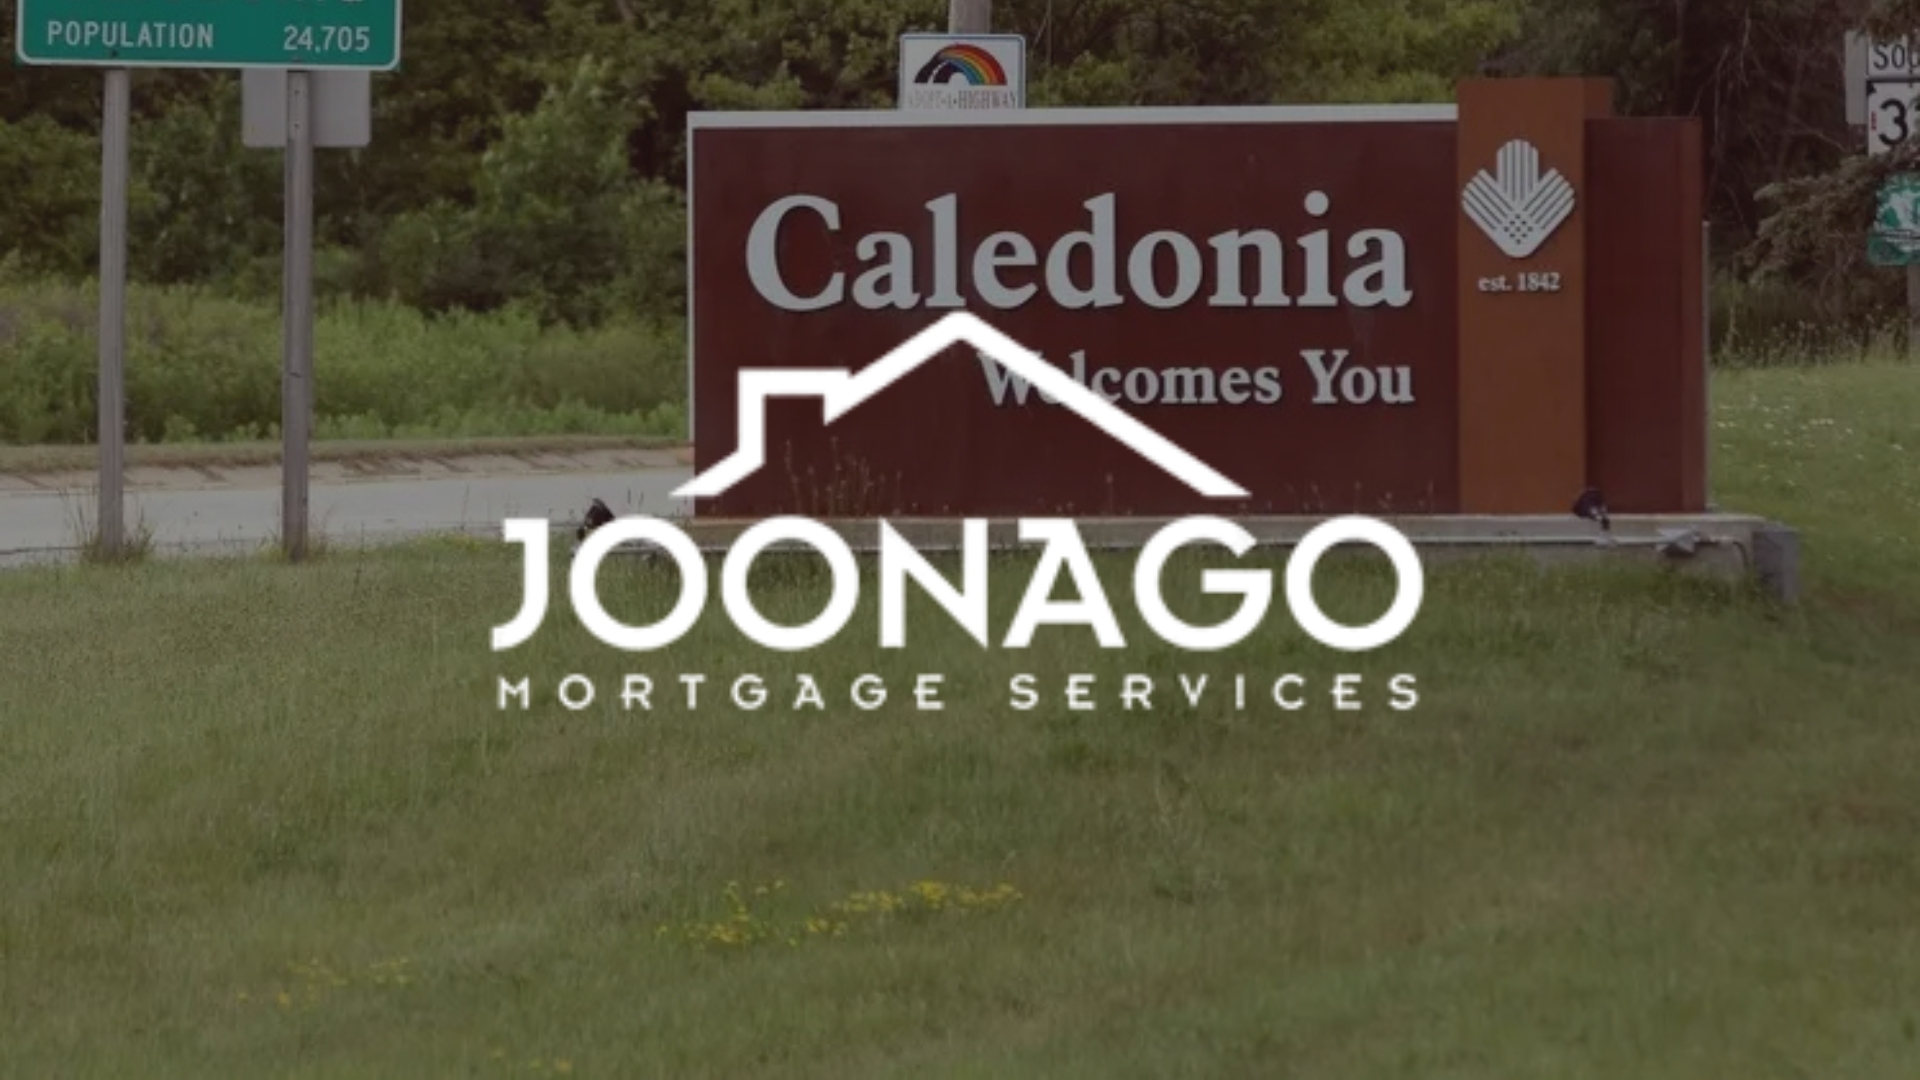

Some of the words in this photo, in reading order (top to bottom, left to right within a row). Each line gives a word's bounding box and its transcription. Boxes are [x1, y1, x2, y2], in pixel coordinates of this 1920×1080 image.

[47, 20, 213, 48] POPULATION
[283, 25, 371, 53] 24,705
[1878, 98, 1920, 146] 3
[746, 190, 1413, 310] Caledonia
[1478, 274, 1512, 292] est.
[1517, 271, 1561, 292] 1842
[1300, 349, 1415, 405] You
